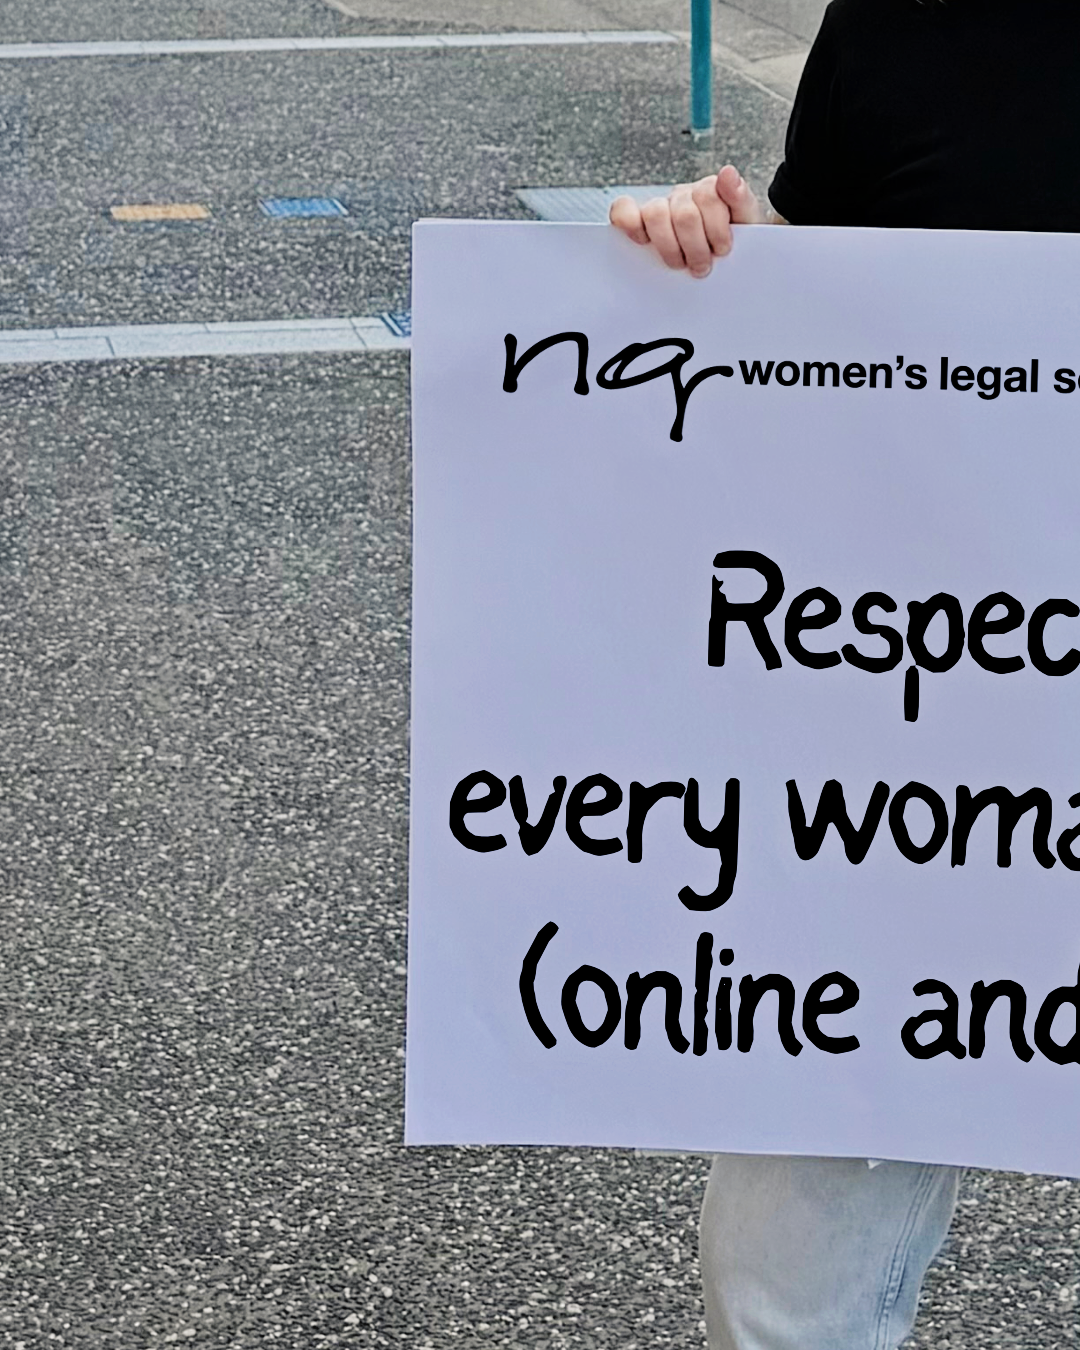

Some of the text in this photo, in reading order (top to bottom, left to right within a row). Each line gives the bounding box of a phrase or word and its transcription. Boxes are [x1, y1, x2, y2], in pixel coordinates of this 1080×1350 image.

[738, 355, 928, 391] women's
[939, 356, 1039, 401] legal
[449, 769, 741, 912] every
[518, 920, 861, 1058] (online
